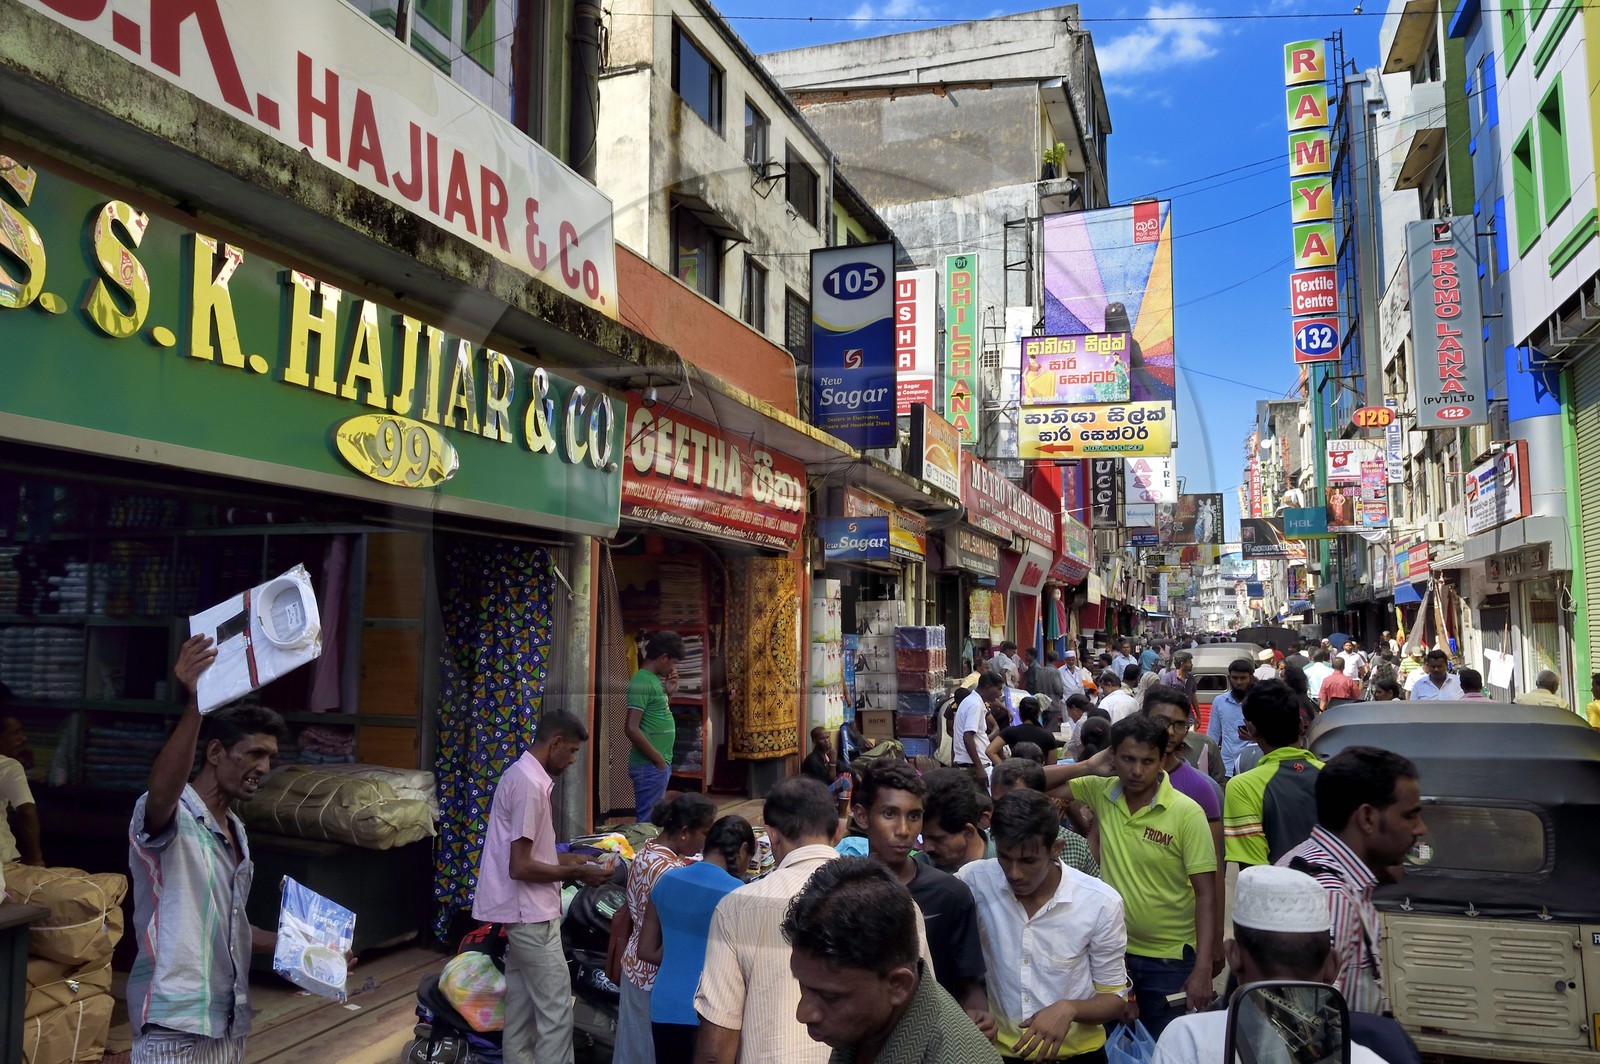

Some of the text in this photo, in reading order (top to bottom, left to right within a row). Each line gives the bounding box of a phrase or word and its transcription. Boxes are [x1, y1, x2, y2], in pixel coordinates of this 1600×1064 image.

[1291, 48, 1329, 258] RAMYA
[297, 50, 511, 253] HAJIAR
[525, 195, 548, 273] &
[558, 219, 607, 306] Co.
[829, 267, 879, 295] 105
[1294, 276, 1334, 292] Textile
[1296, 291, 1334, 308] Centre
[898, 282, 912, 369] USHA
[1431, 247, 1466, 394] PROMO LANKA
[1297, 327, 1333, 350] 132
[280, 268, 515, 444] HAJIAR
[524, 367, 557, 455] &
[563, 384, 619, 473] CO.
[820, 377, 842, 386] New
[820, 387, 888, 409] Sagar
[1423, 394, 1475, 406] (PVT)LTD
[1358, 409, 1390, 427] 126
[1442, 409, 1464, 418] 122
[374, 419, 432, 483] 99
[631, 407, 743, 498] GEETHA
[971, 460, 1005, 506] METRO
[1006, 485, 1031, 521] TRADE
[660, 512, 685, 525] Second
[684, 516, 703, 528] Cross
[703, 519, 722, 534] Street,
[1290, 520, 1313, 528] HBL
[839, 536, 887, 552] Sagar
[1143, 826, 1173, 847] FRIDAY
